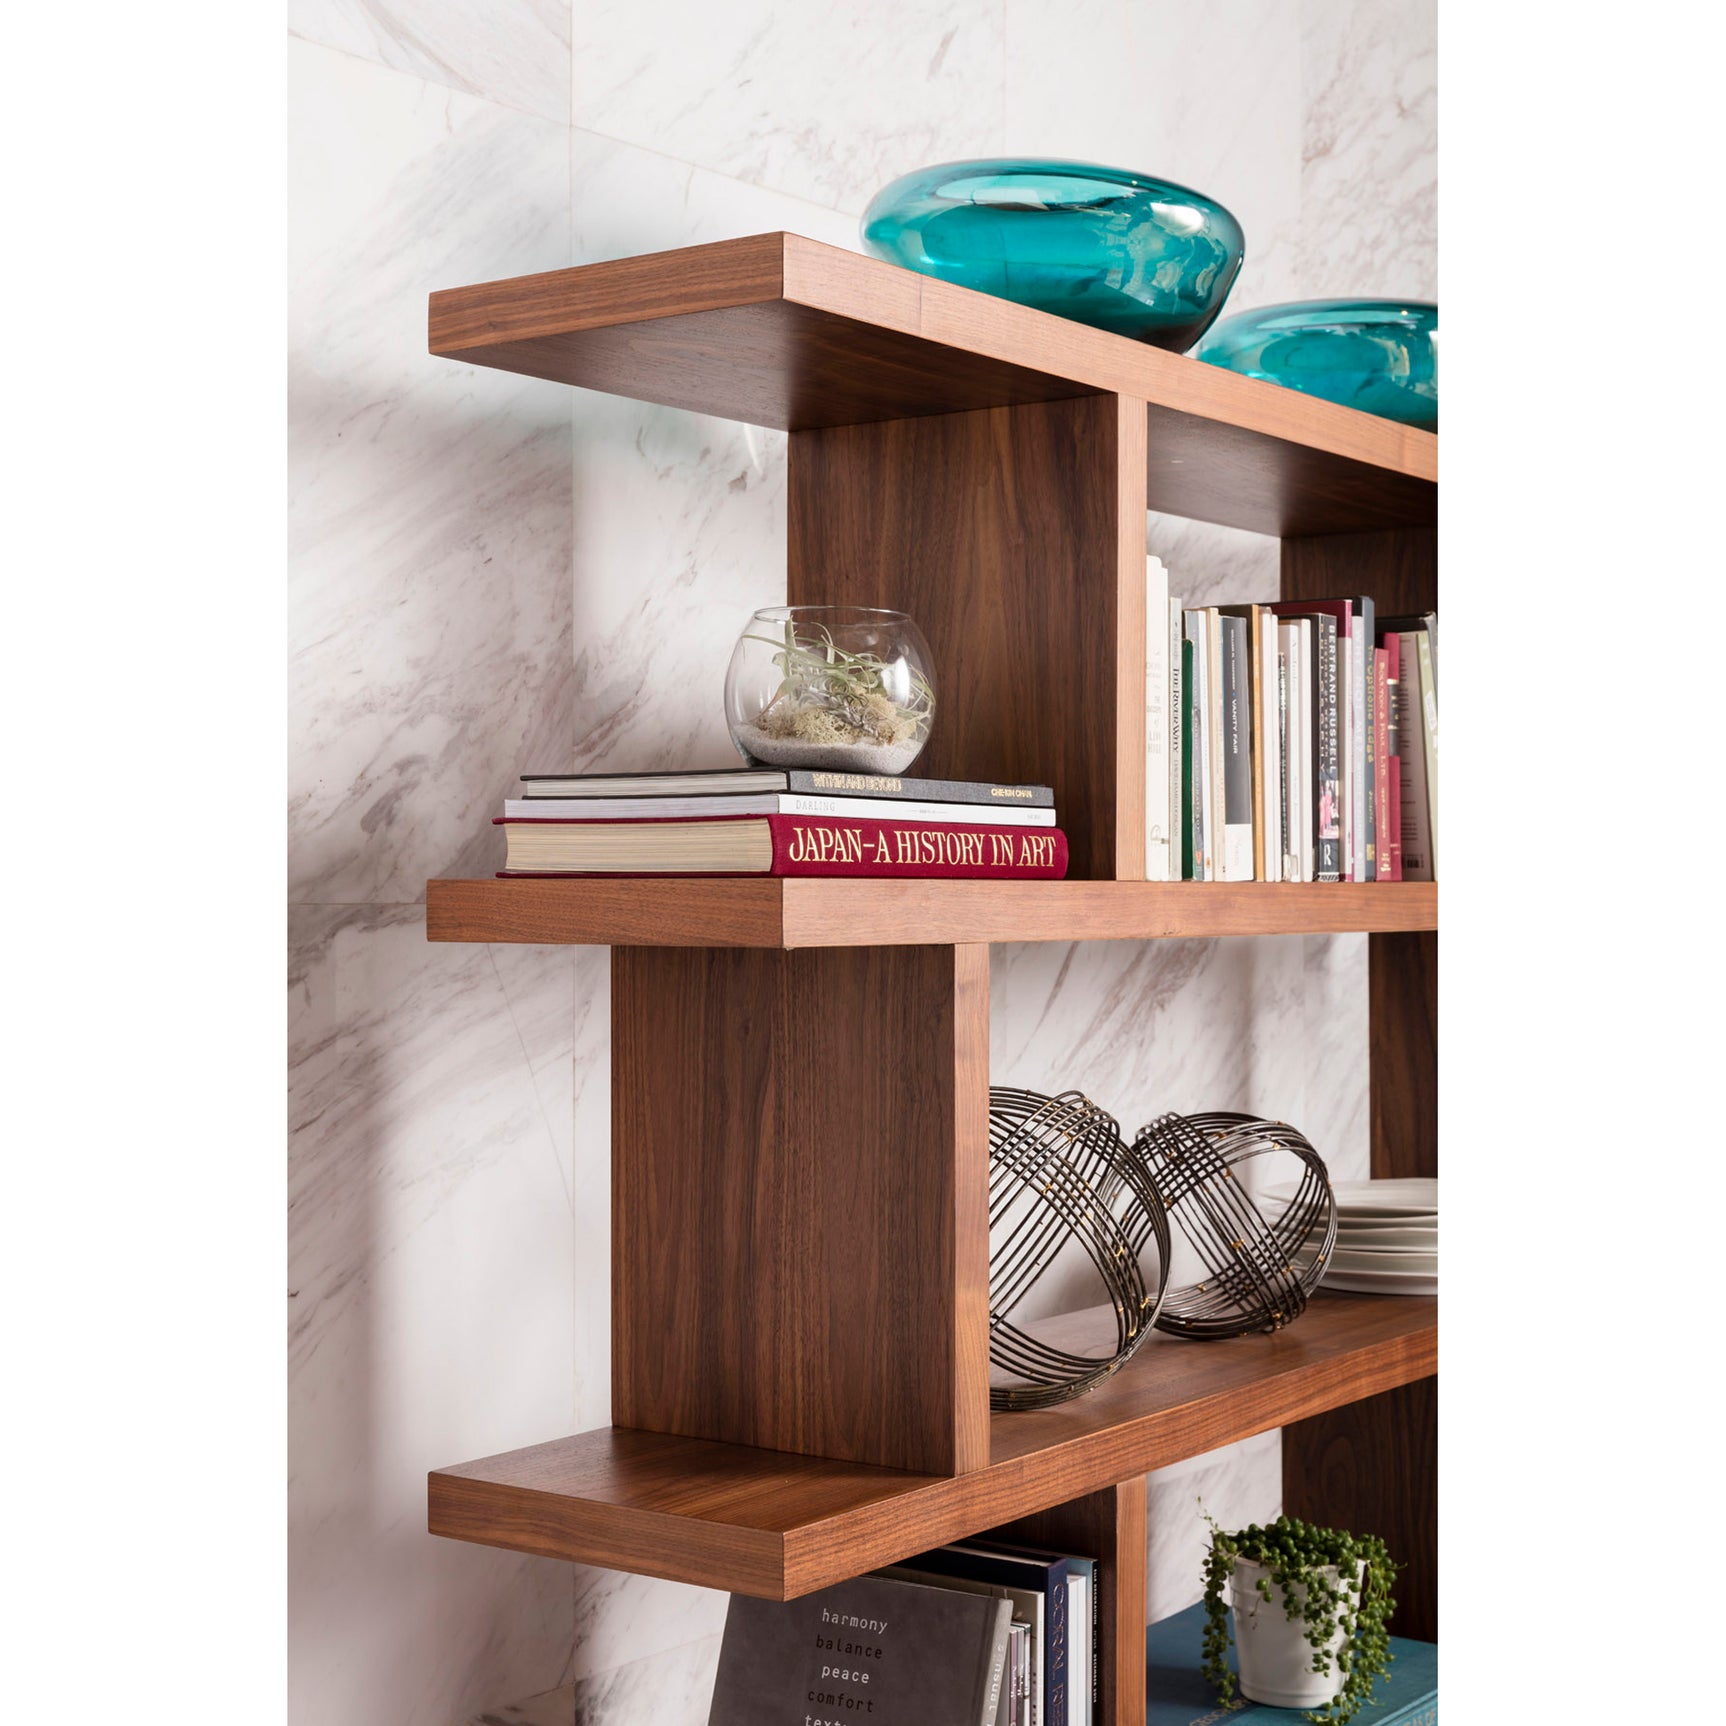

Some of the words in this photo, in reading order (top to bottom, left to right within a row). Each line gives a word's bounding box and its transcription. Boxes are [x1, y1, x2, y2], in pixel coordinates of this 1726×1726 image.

[1172, 668, 1180, 688] THE
[1328, 624, 1337, 704] BERTRAND
[1172, 690, 1180, 724] RIVER
[1366, 664, 1375, 721] Options
[1172, 725, 1180, 753] WHY
[1329, 707, 1337, 774] RUSSELL
[1366, 725, 1375, 763] Edge
[795, 799, 836, 812] DARLING
[893, 830, 985, 865] HISTORY
[985, 834, 1014, 867] IN
[1015, 836, 1057, 867] ART
[822, 1608, 888, 1634] harmony
[1052, 1583, 1065, 1681] CORAL
[816, 1635, 883, 1660] balance
[821, 1666, 870, 1684] peace
[989, 1644, 1004, 1712] snsual
[807, 1691, 875, 1713] comfort
[805, 1715, 847, 1726] tex
